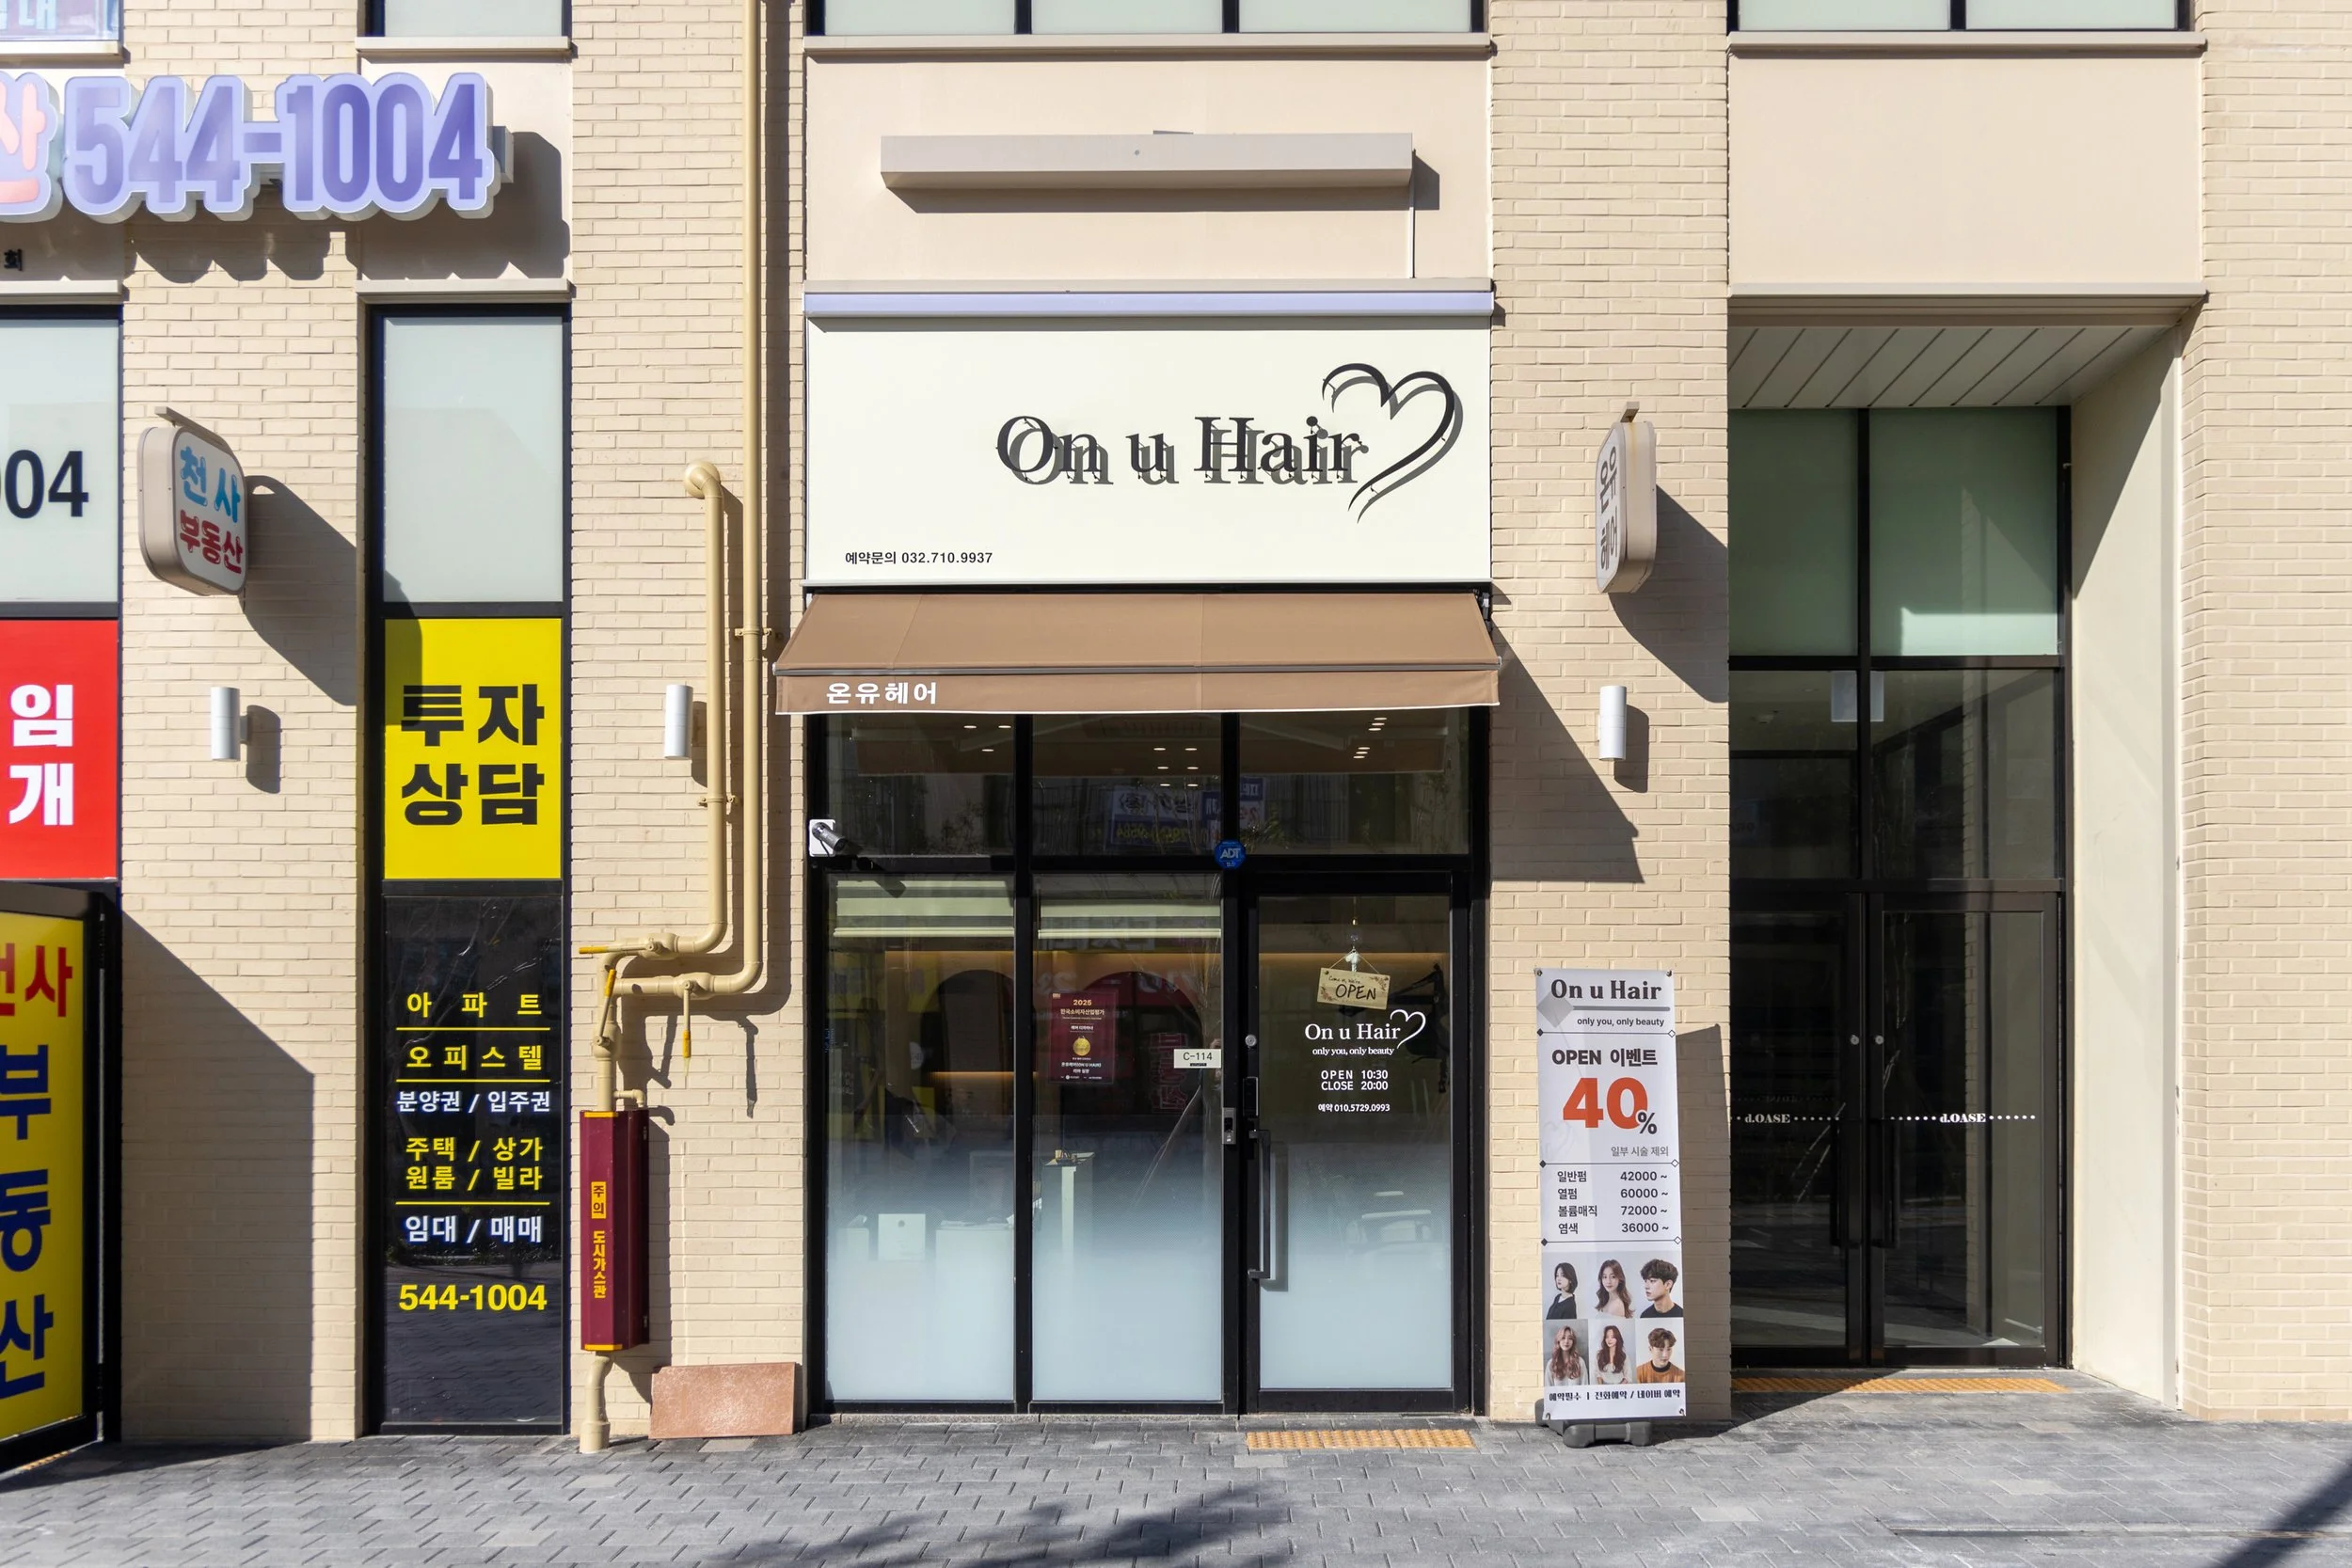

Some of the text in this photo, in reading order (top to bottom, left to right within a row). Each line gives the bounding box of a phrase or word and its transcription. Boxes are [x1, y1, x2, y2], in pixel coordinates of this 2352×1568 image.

[75, 83, 484, 204] 544-1004
[997, 416, 1360, 473] On u Hair
[0, 450, 89, 519] 04
[181, 446, 241, 523] 천사
[1599, 446, 1617, 515] 온유
[180, 510, 243, 575] 부동산
[1600, 505, 1617, 570] 헤어
[845, 551, 993, 564] 예약문의 032.710.9937
[826, 682, 936, 705] 온유헤어
[401, 684, 545, 746] 투자
[402, 763, 545, 825] 상담
[1220, 848, 1241, 859] ADT
[1335, 984, 1376, 1001] OPEN
[1551, 979, 1661, 1000] On u Hair
[1305, 1023, 1401, 1040] On u Hair
[1577, 1018, 1595, 1027] only
[1616, 1019, 1634, 1027] only
[1636, 1019, 1664, 1027] beauty
[1183, 1052, 1213, 1061] C-114
[1331, 1048, 1348, 1056] you,
[1368, 1047, 1394, 1055] beauty
[1551, 1048, 1658, 1067] OPEN 이벤트
[1321, 1070, 1389, 1080] OPEN 10:30
[1321, 1081, 1389, 1091] CLOSE 20:00
[397, 1091, 461, 1112] 분양권
[487, 1091, 550, 1112] 입주권
[1318, 1103, 1391, 1113] 예약 010.5729.0993
[1744, 1114, 1791, 1123] d.OASE
[1940, 1113, 1987, 1123] d.OASE
[405, 1136, 456, 1162] 주택
[492, 1136, 543, 1162] 상가
[1611, 1146, 1669, 1157] 일부 시술 제외
[405, 1165, 455, 1190] 원룸
[493, 1165, 543, 1191] 빌라
[1557, 1170, 1586, 1182] 일반펌
[1620, 1171, 1657, 1180] 42000
[594, 1185, 604, 1214] 주의
[1558, 1188, 1577, 1200] 열펌
[1620, 1188, 1658, 1198] 60000
[1558, 1205, 1597, 1217] 볼륨매직
[1621, 1205, 1657, 1215] 72000
[405, 1215, 456, 1243] 임대
[491, 1215, 542, 1243] 매매
[1558, 1223, 1579, 1234] 염색
[1621, 1223, 1659, 1233] 36000
[594, 1230, 606, 1299] 도시가스관
[399, 1284, 548, 1310] 544-1004
[1549, 1392, 1581, 1402] 예약필수
[1595, 1391, 1628, 1401] 전화예약
[1637, 1390, 1661, 1399] 네이버
[1664, 1389, 1680, 1398] 예약
